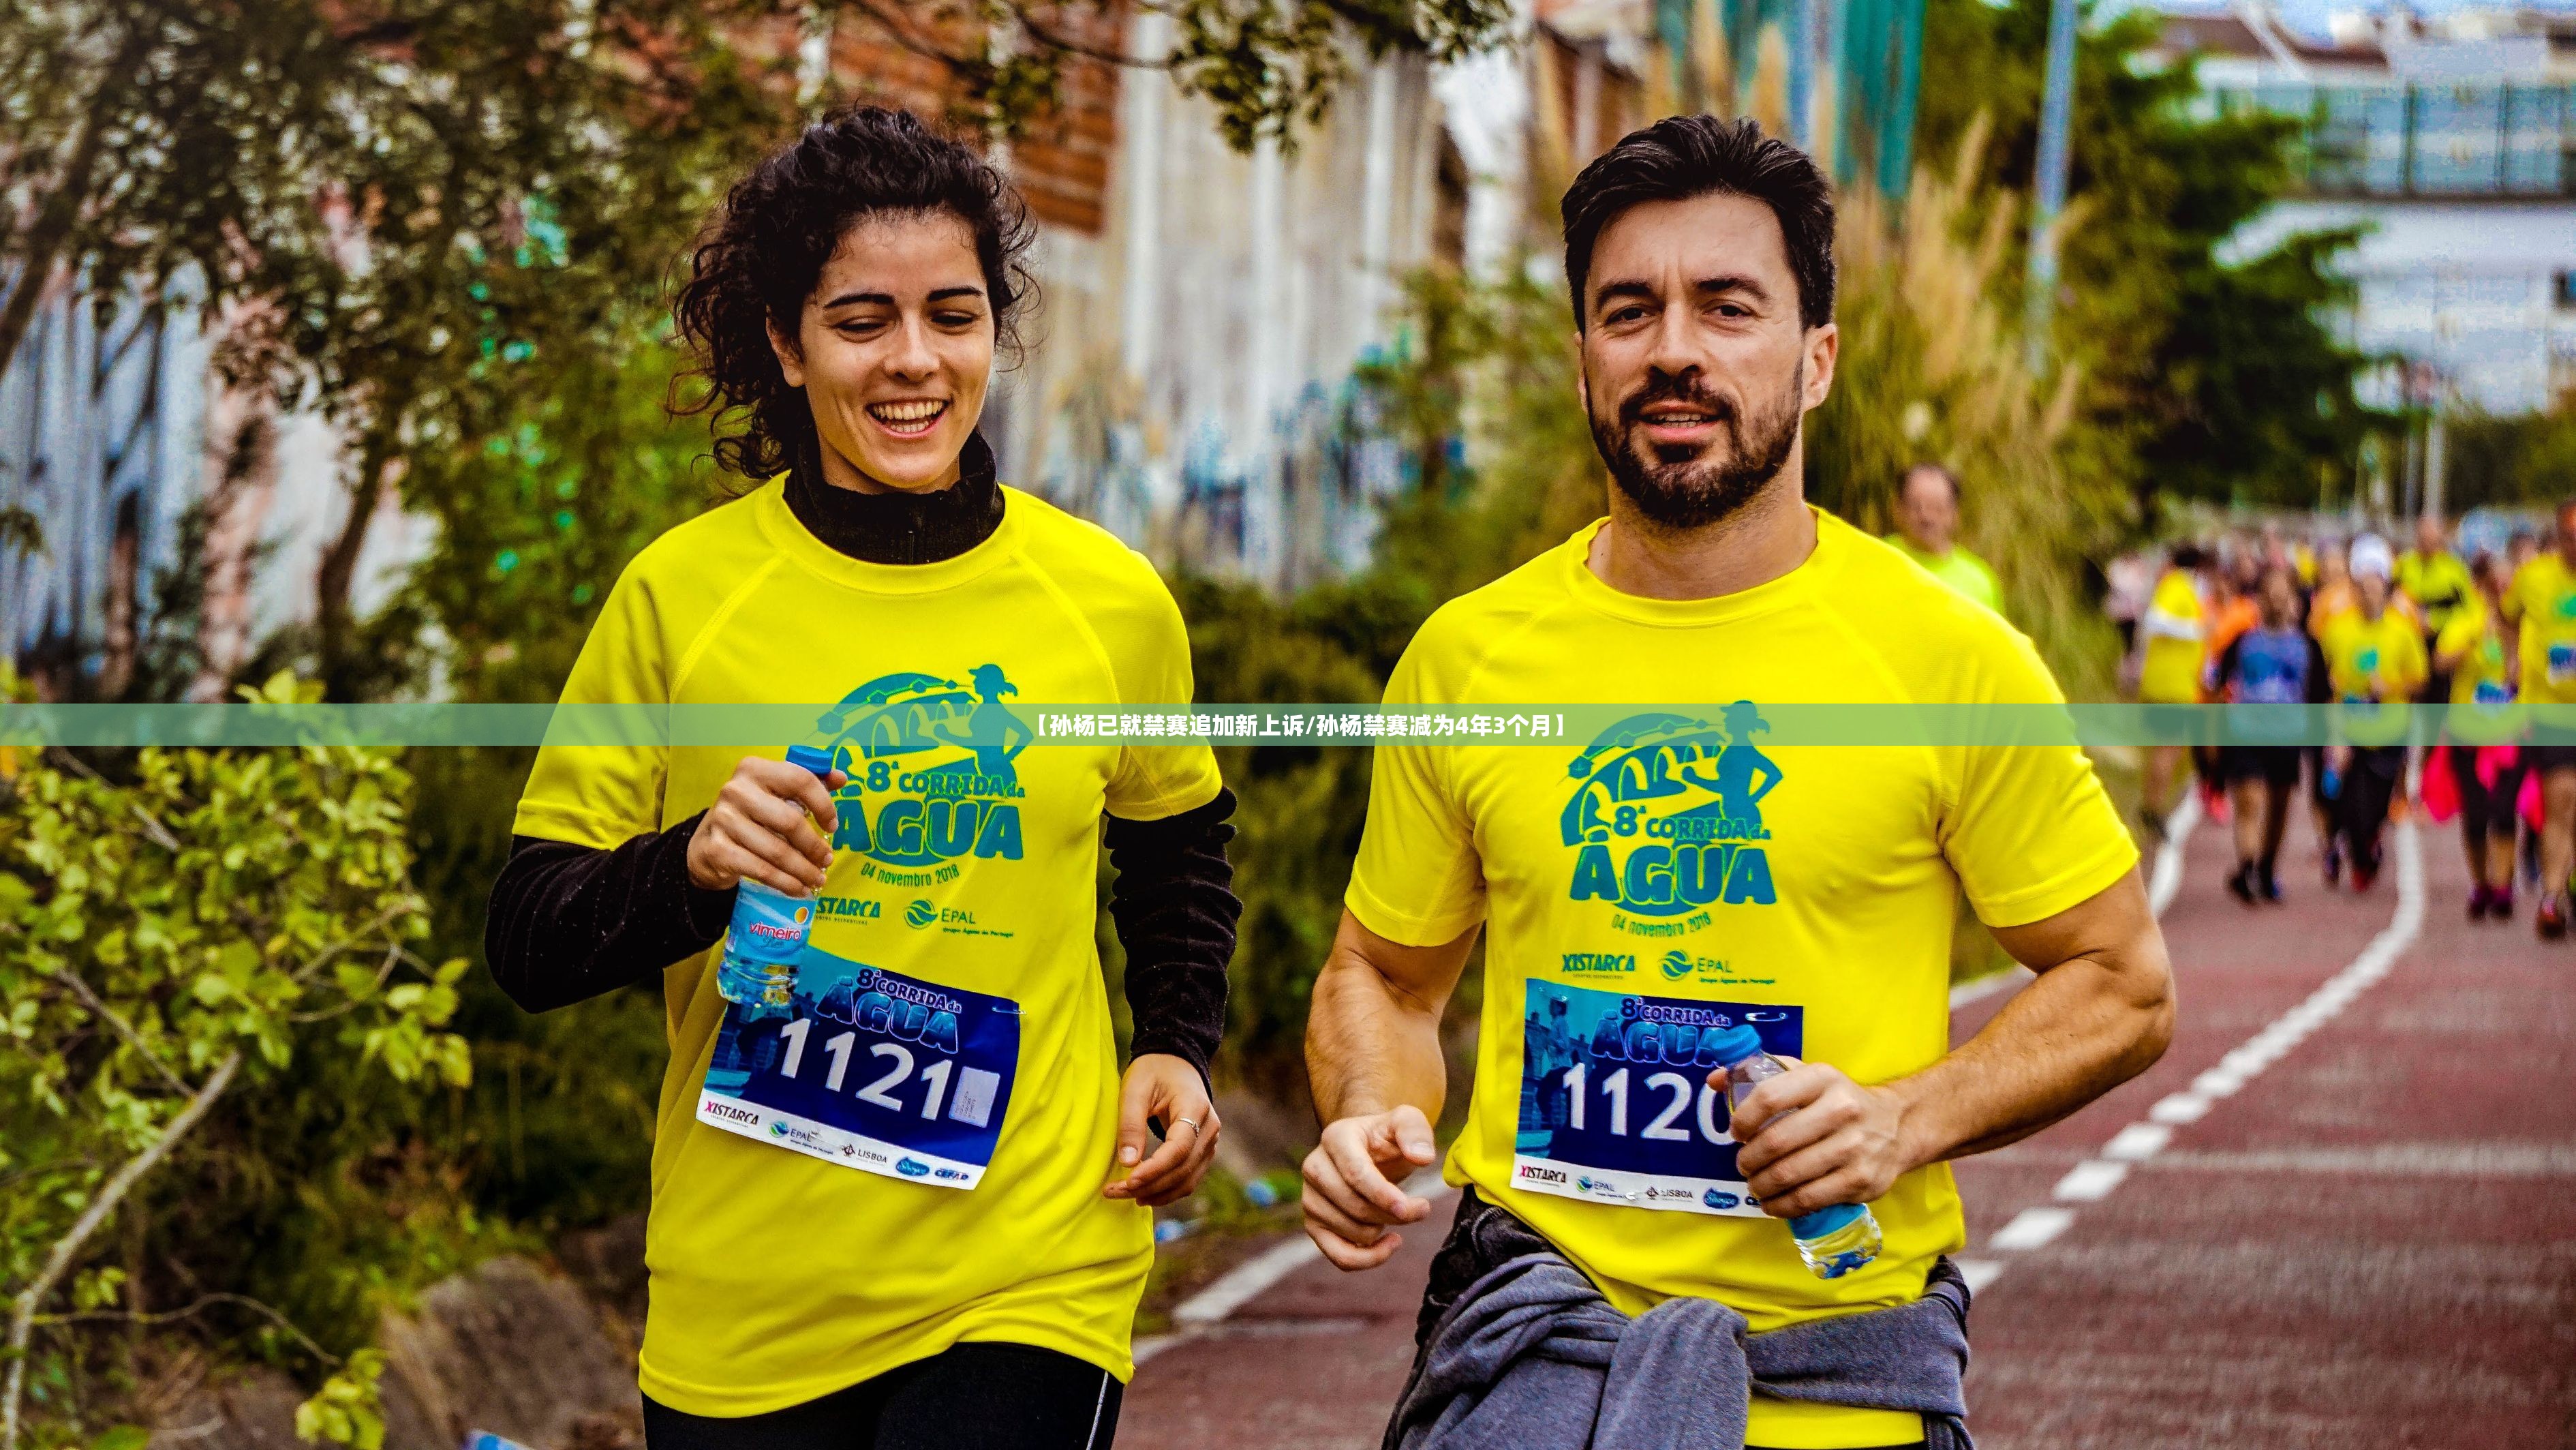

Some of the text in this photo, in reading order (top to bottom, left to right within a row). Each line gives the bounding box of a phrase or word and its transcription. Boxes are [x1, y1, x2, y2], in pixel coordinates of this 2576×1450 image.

[899, 773, 1005, 797] CORRIDA
[1005, 781, 1025, 798] da
[832, 783, 1024, 860] ÁGUA
[1646, 817, 1748, 840] CORRIDA
[1750, 824, 1771, 840] da
[861, 862, 960, 887] 04 novembro 2018
[1569, 828, 1777, 905] ÁGUA
[817, 897, 880, 918] STARCA
[941, 908, 976, 924] EPAL
[750, 921, 801, 941] vimeiro
[1612, 911, 1711, 937] 04 novembro 2018
[1562, 954, 1635, 971] XISTARCA
[1697, 957, 1733, 973] EPAL
[876, 978, 947, 1011] CORRIDA
[947, 999, 962, 1014] da
[815, 976, 958, 1054] ÁGUA
[1640, 1005, 1715, 1025] CORRIDA
[1714, 1014, 1731, 1027] da
[780, 1018, 953, 1121] 1121
[705, 1100, 759, 1126] XISTARCA
[791, 1128, 810, 1142] EPAL
[857, 1149, 887, 1163] LISBOA
[1520, 1165, 1566, 1183] XISTARCA
[1594, 1181, 1614, 1192] EPAL
[1661, 1190, 1693, 1198] LISBOA
